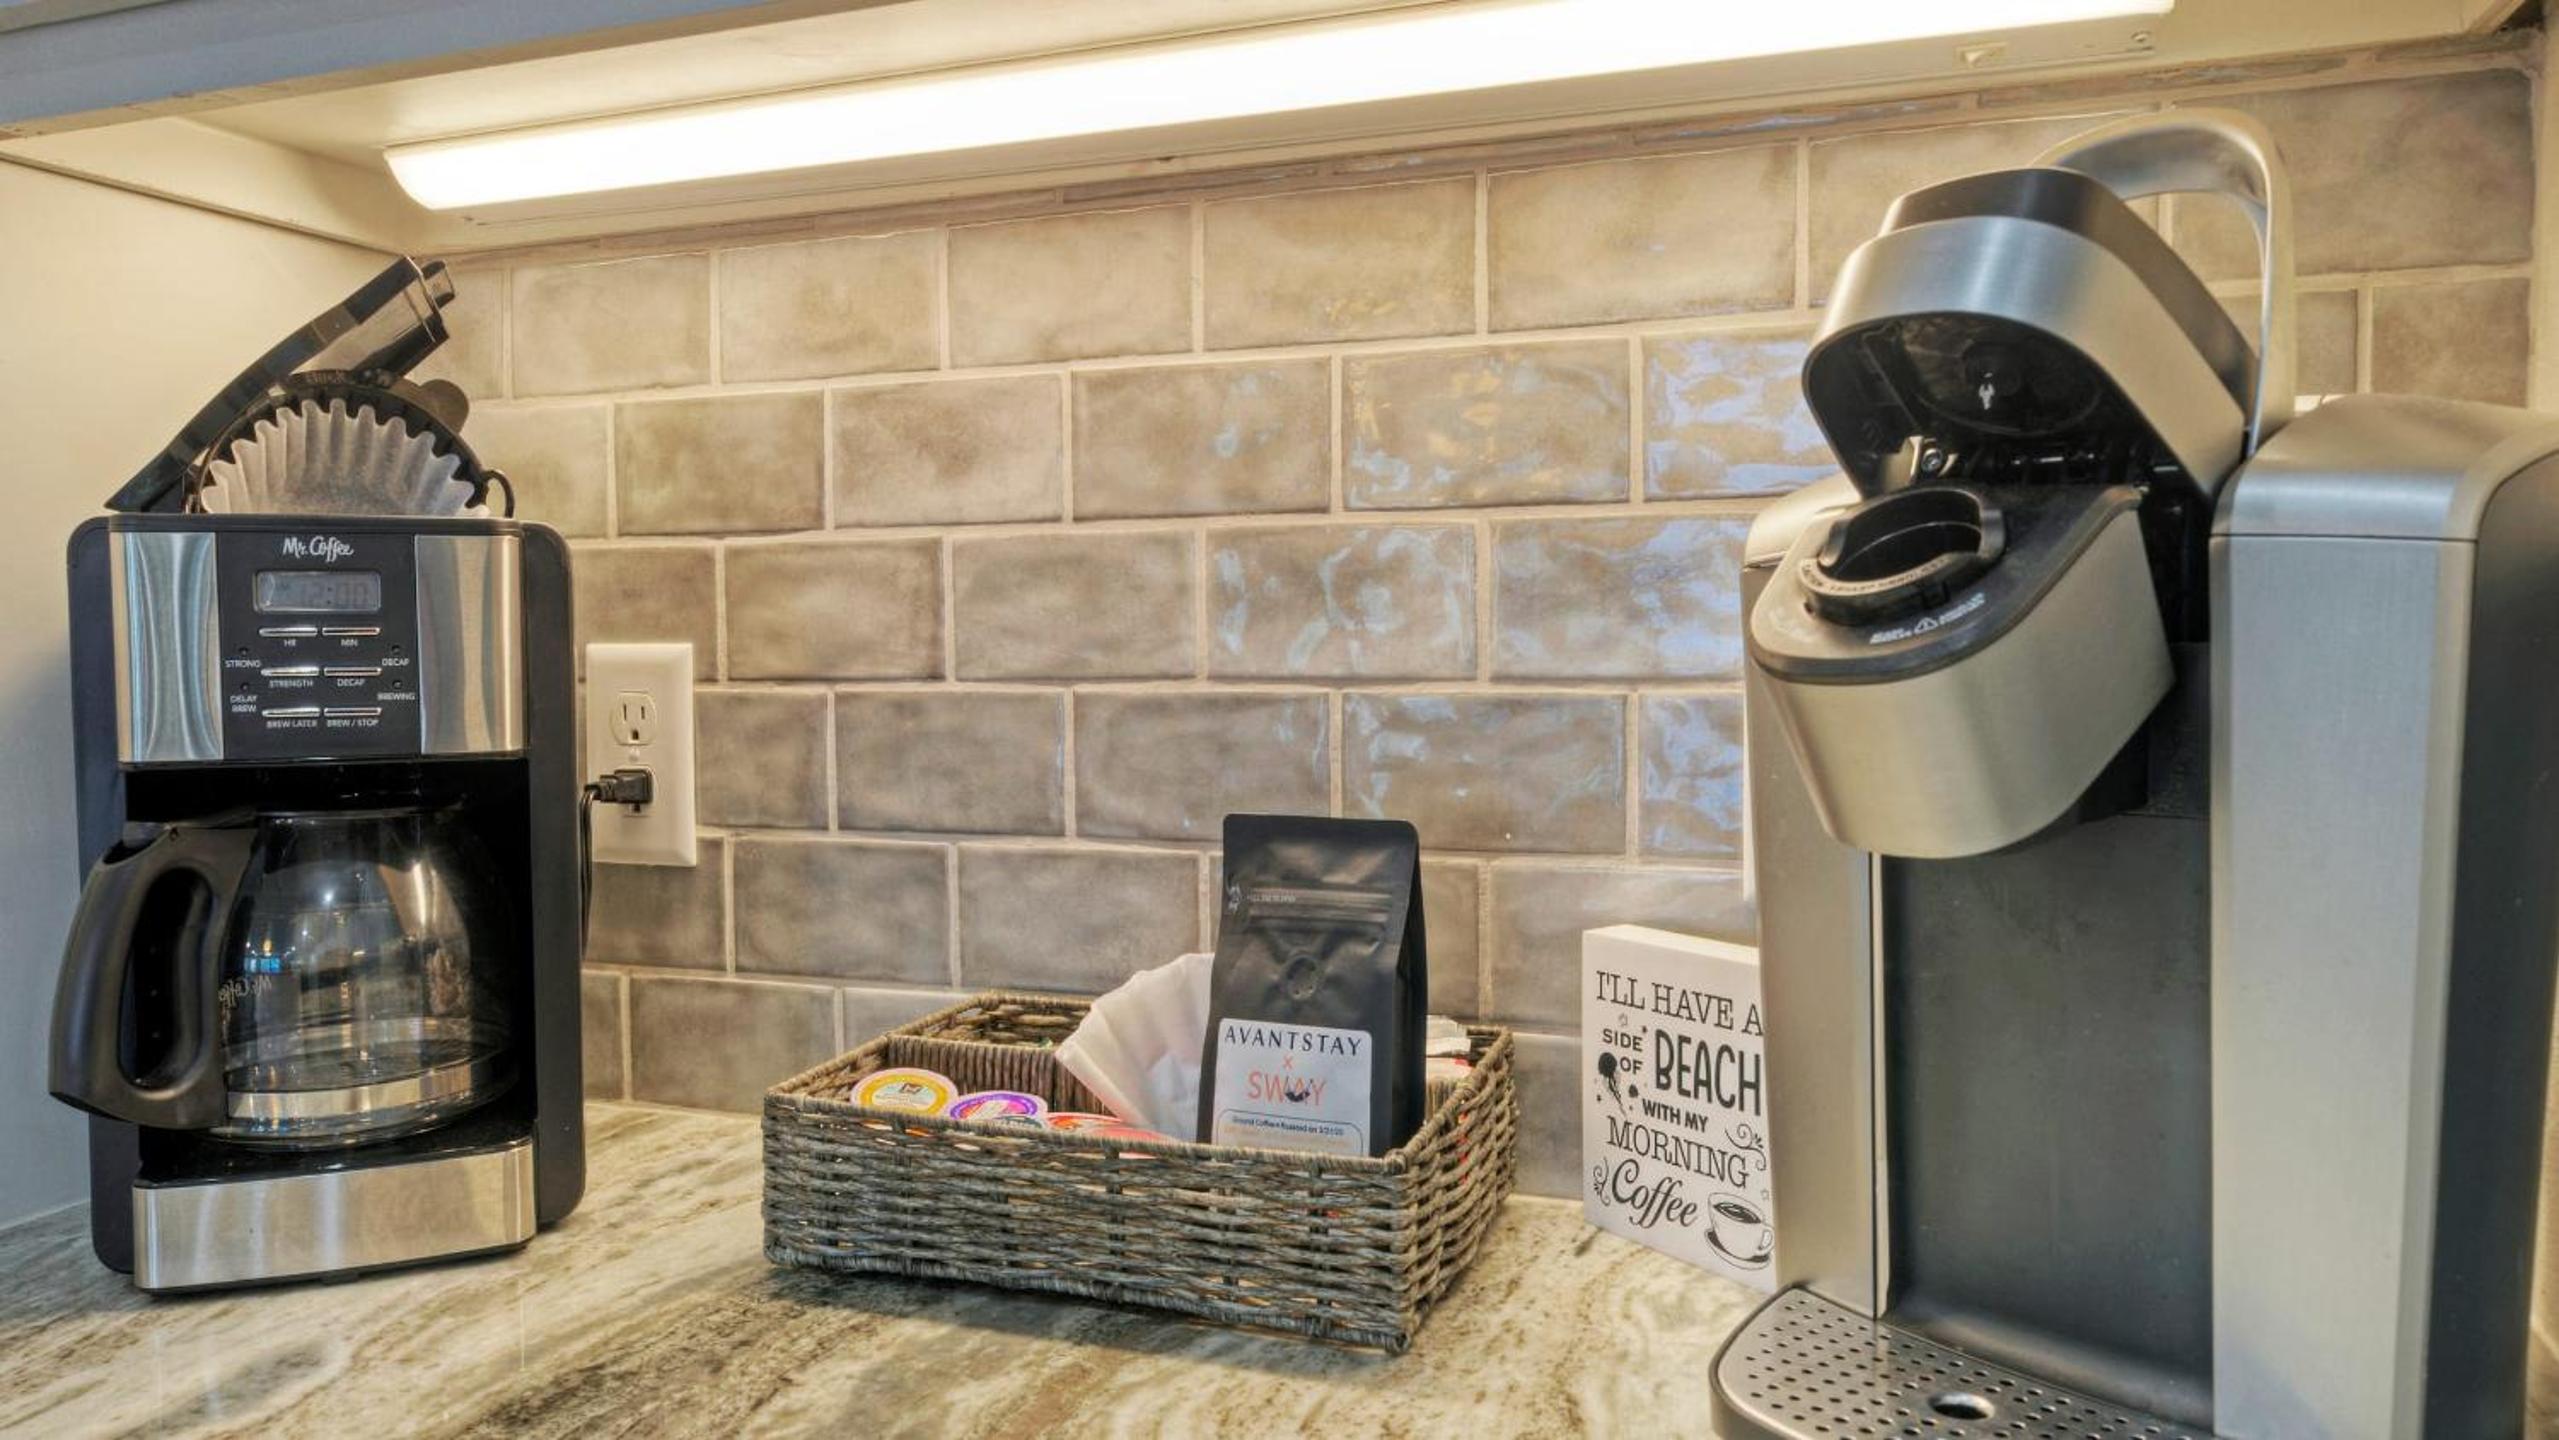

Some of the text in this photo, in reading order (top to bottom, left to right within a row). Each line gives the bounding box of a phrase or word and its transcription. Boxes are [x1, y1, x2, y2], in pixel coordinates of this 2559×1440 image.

[283, 535, 354, 562] Mr. Coffee
[284, 639, 296, 647] HR
[341, 639, 358, 647] MIN
[225, 659, 261, 668] STRONG
[382, 657, 410, 667] DECAF
[269, 680, 313, 688] STRENGTH
[337, 679, 365, 687] DECAF
[230, 695, 257, 703] DELAY
[378, 693, 415, 701] BREWING
[232, 705, 257, 713] BREW
[267, 719, 317, 728] BREW LATER
[327, 719, 350, 727] BREW
[357, 718, 379, 727] STOP
[1596, 970, 1765, 1036] I'LL HAVE A
[1224, 1025, 1361, 1056] AVANTSTAY
[1602, 1027, 1643, 1052] SIDE
[1619, 1055, 1644, 1075] OF
[1655, 1029, 1761, 1117] BEACH
[1641, 1098, 1708, 1133] WITH MY
[1606, 1114, 1750, 1190] MORNING
[1611, 1157, 1699, 1229] Coffee
